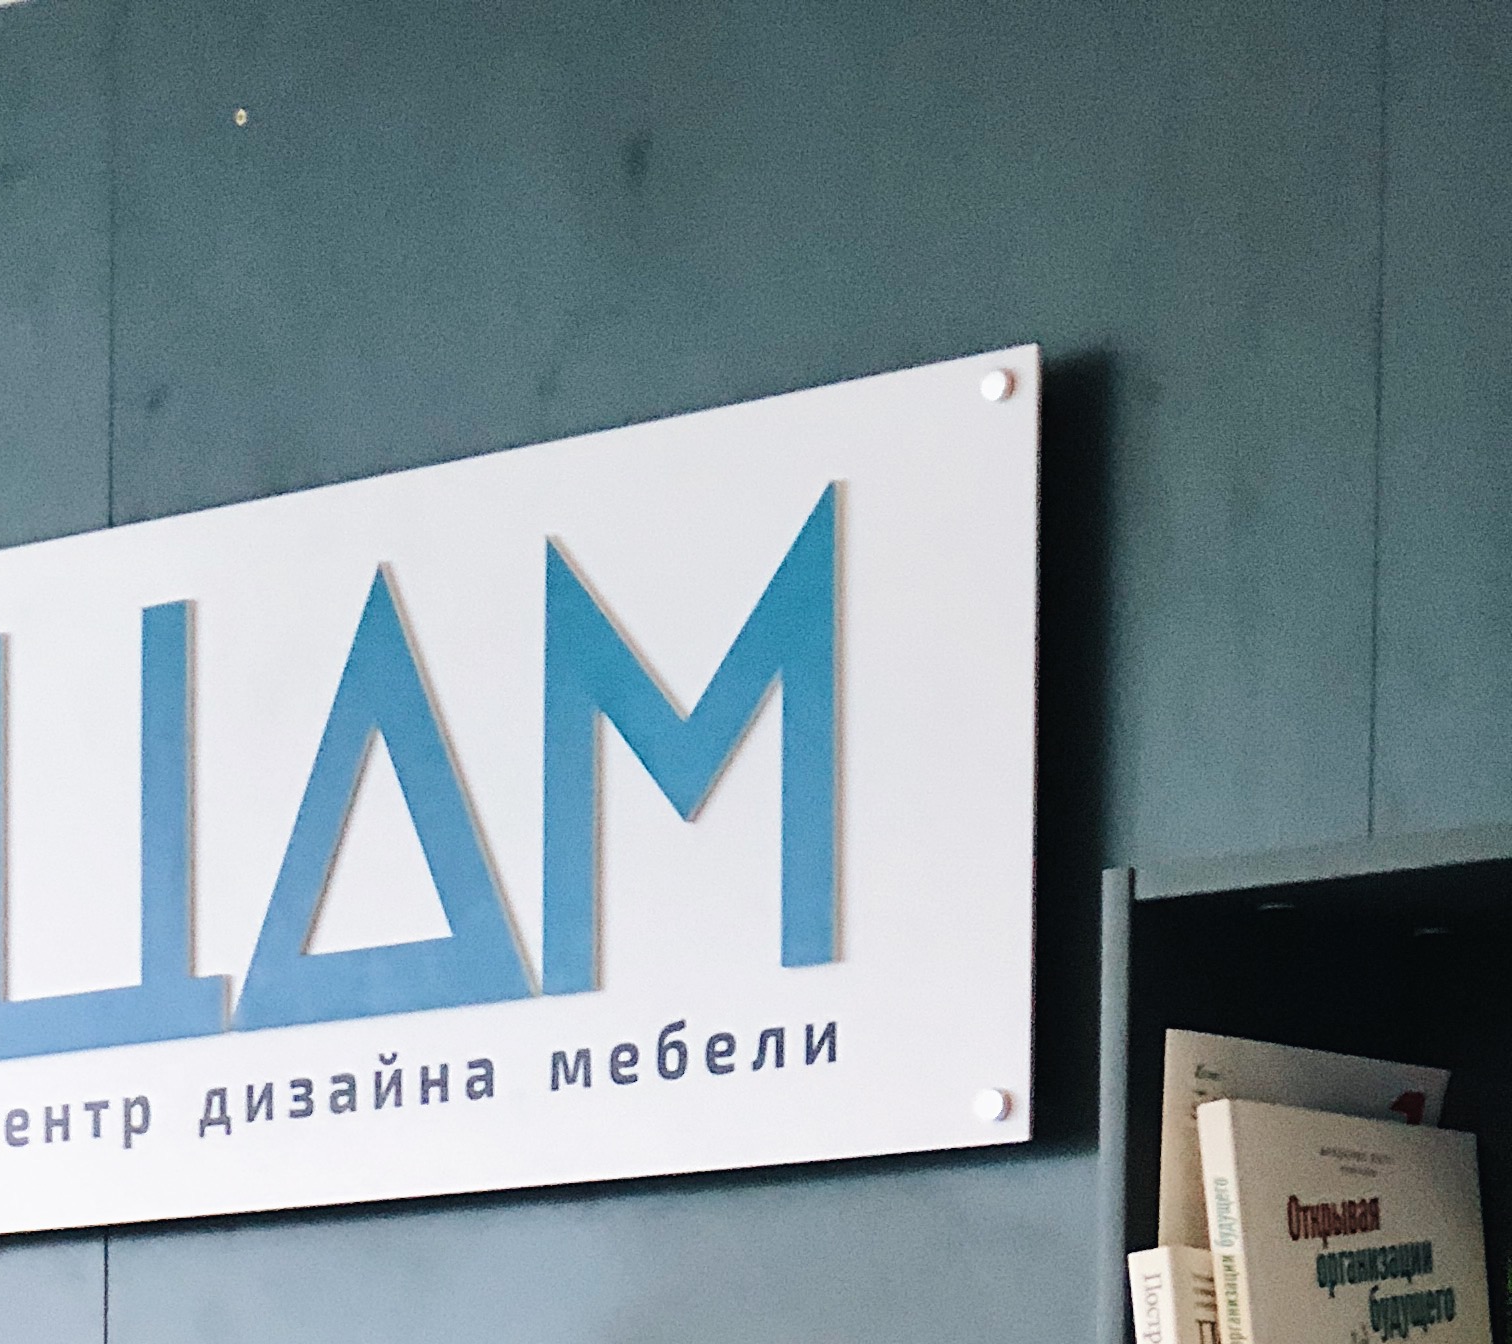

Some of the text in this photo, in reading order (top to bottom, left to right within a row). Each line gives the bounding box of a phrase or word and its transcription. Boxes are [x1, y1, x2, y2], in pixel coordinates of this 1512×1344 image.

[197, 1051, 495, 1139] дизайна
[550, 1018, 841, 1094] мебели
[1214, 1177, 1237, 1251] будущего
[1287, 1194, 1381, 1249] Открывая
[1316, 1239, 1433, 1299] организации
[1369, 1284, 1456, 1343] будущего
